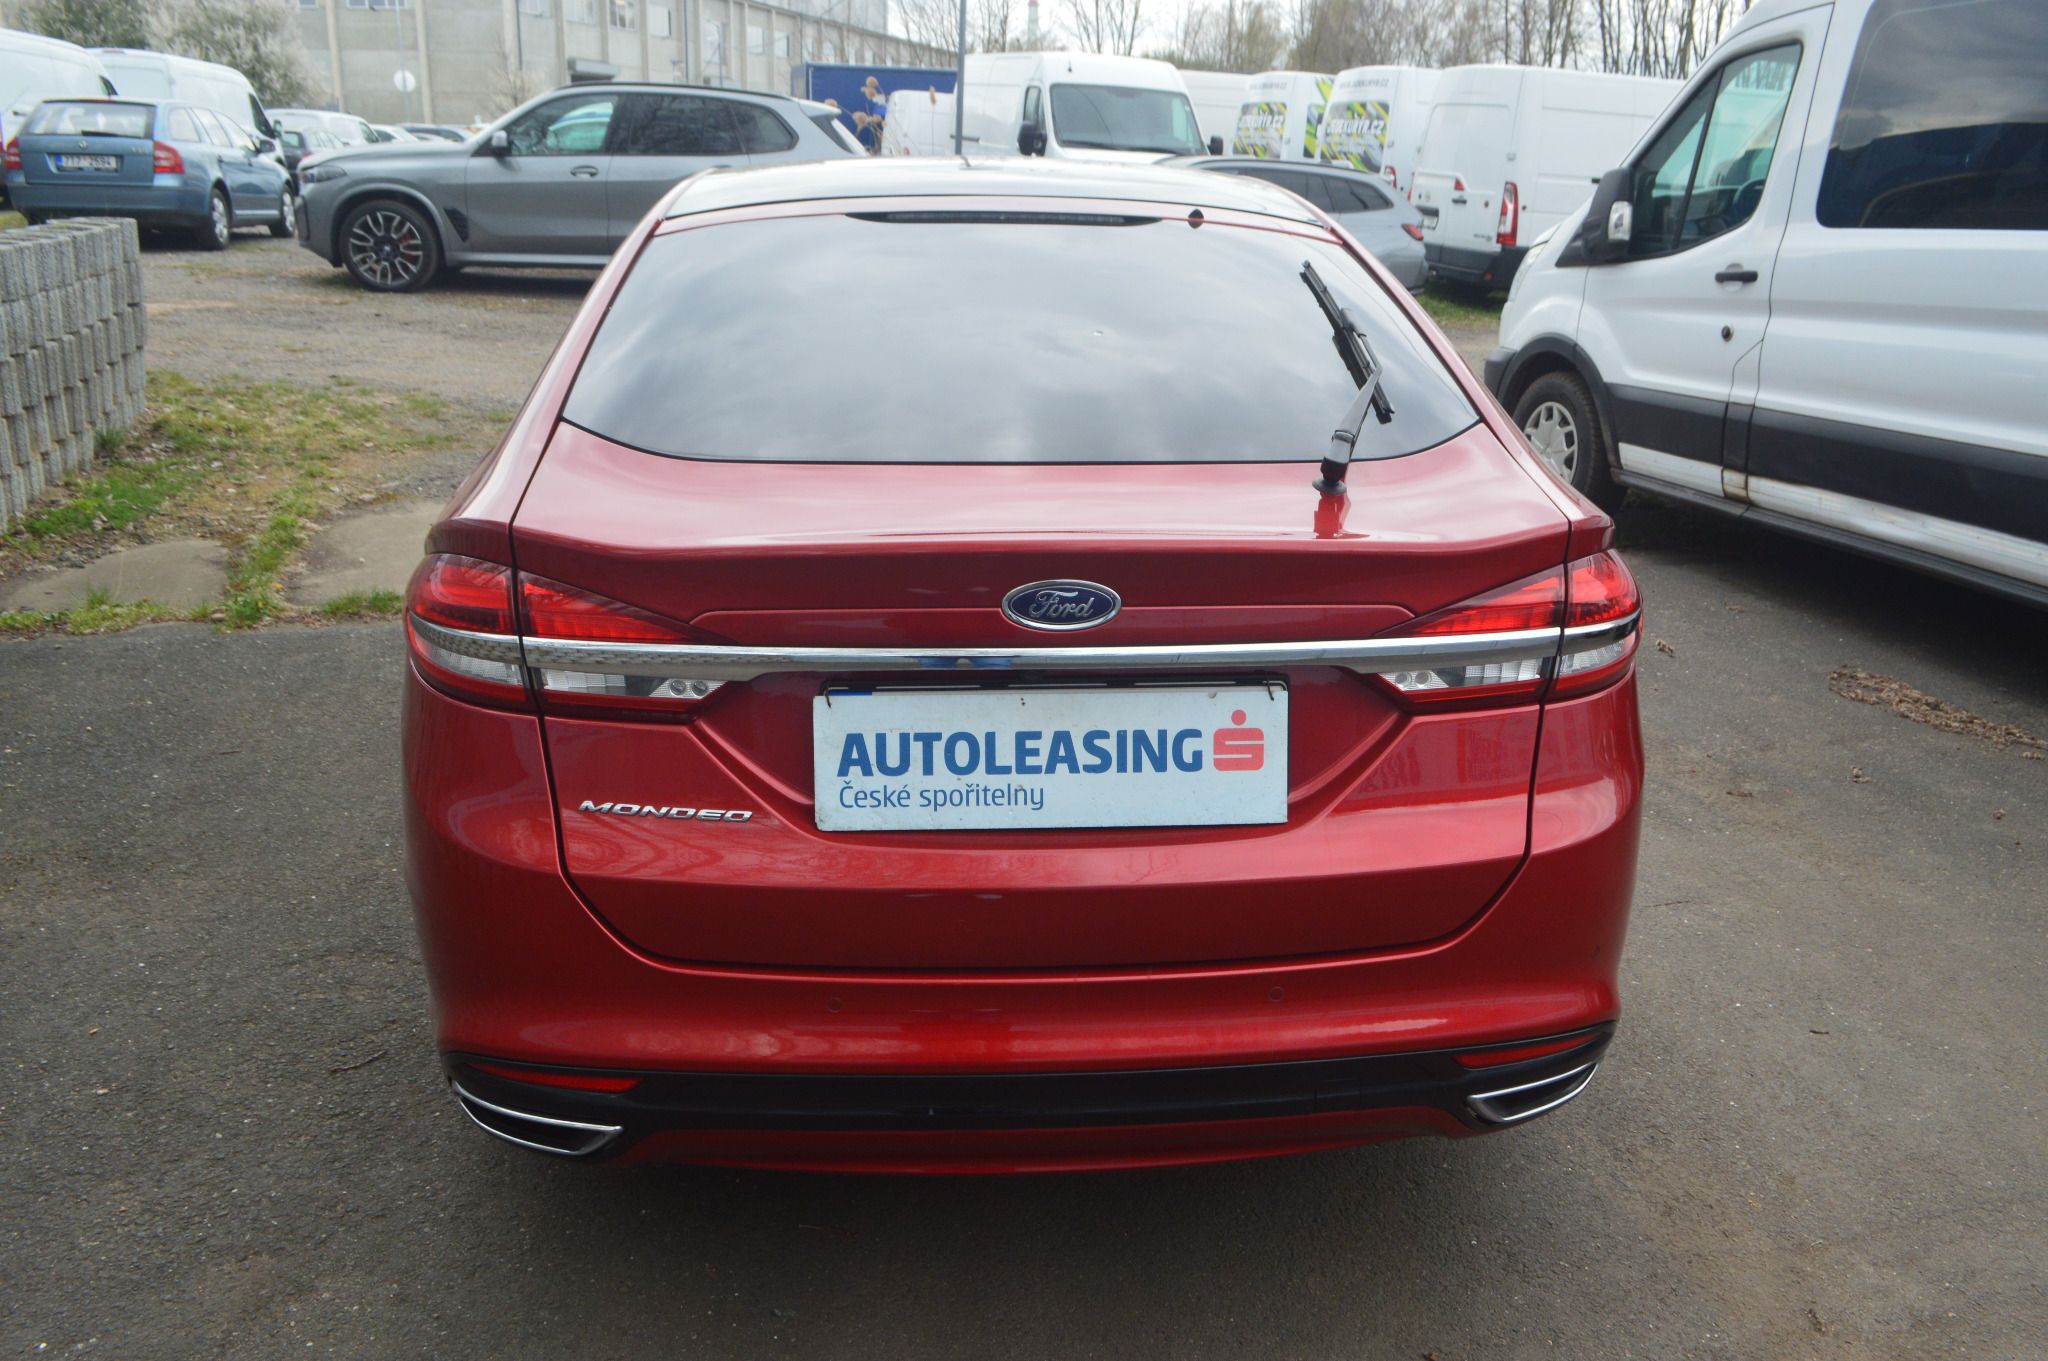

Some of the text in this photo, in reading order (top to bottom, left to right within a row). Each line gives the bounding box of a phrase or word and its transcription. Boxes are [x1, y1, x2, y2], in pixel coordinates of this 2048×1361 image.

[1029, 590, 1095, 618] Ford
[836, 729, 1203, 777] AUTOLEASING
[839, 780, 1045, 812] České spořitelny
[578, 800, 753, 823] MONDEO
